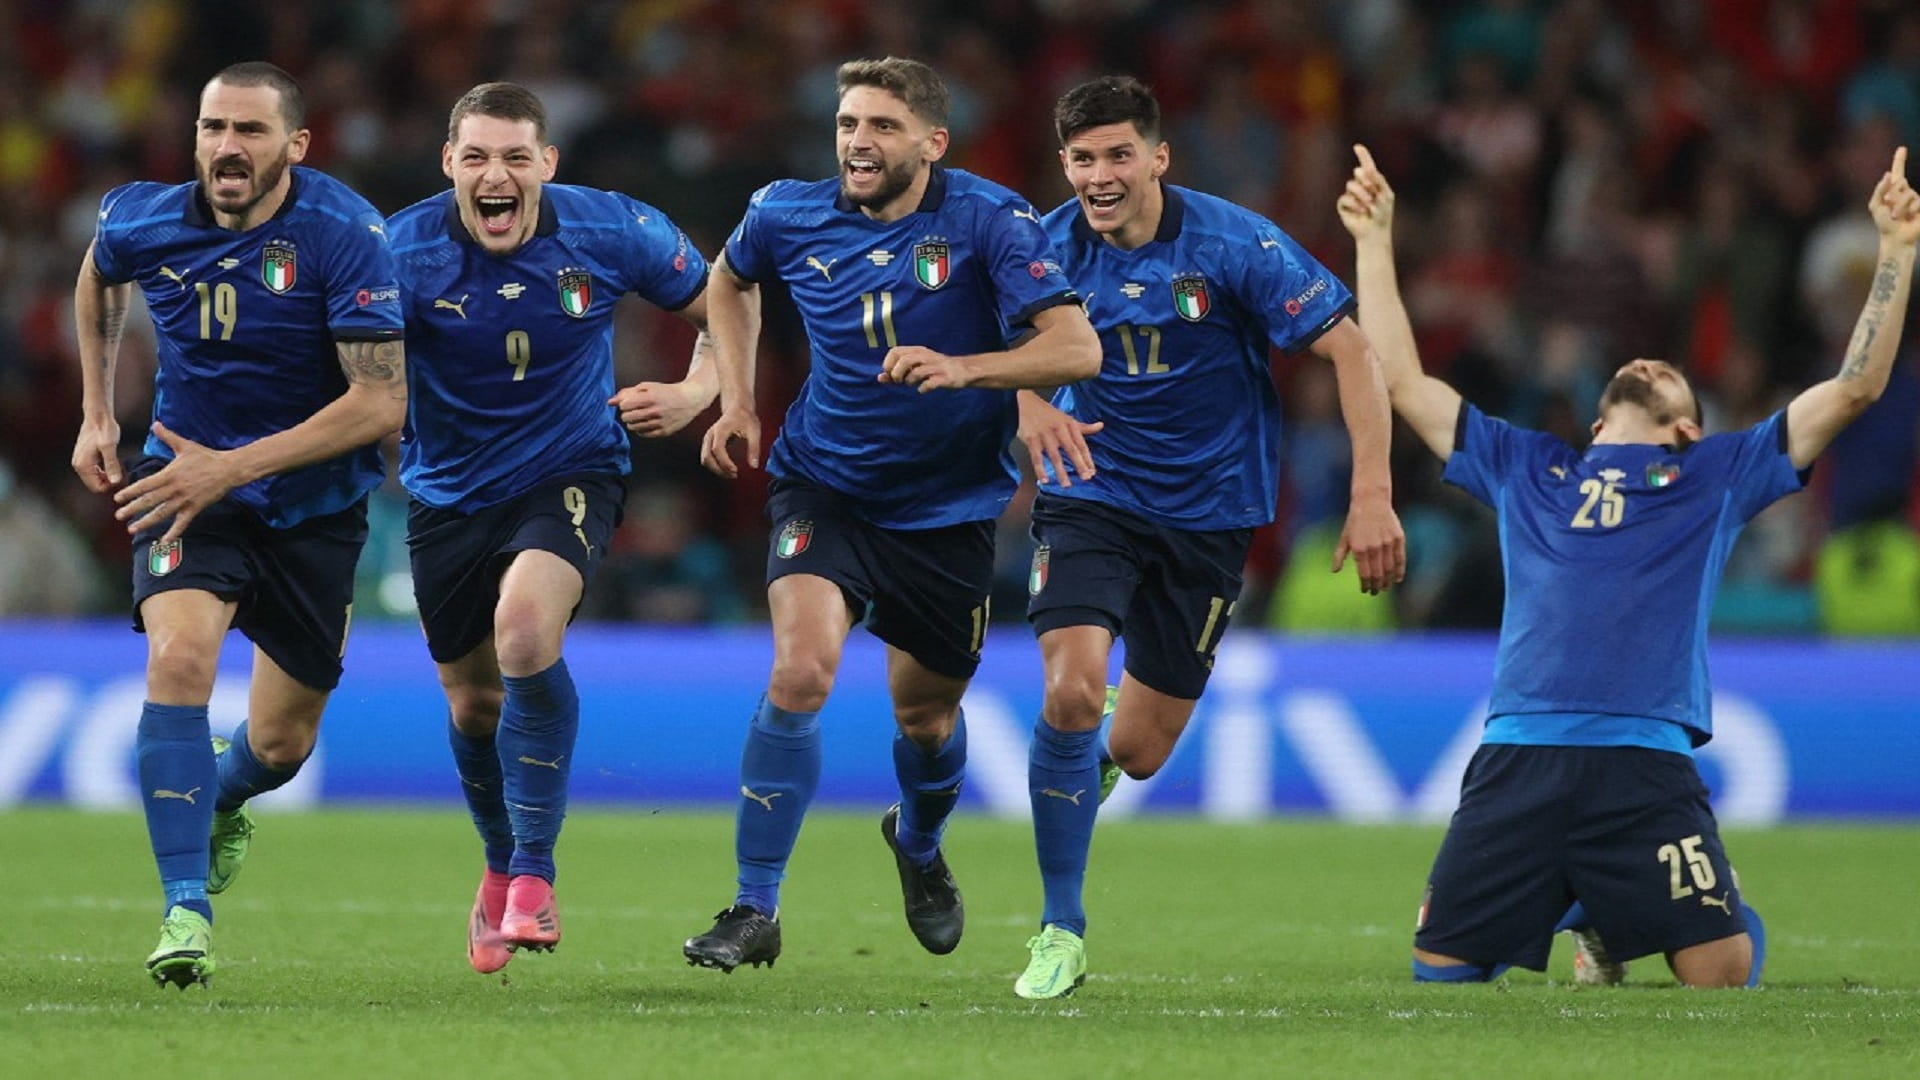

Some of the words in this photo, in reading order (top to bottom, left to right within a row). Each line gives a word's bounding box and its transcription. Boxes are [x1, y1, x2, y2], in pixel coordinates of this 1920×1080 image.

[195, 282, 238, 341] 19
[1297, 279, 1328, 305] RESPECT
[861, 292, 897, 348] 11
[505, 330, 531, 381] 9
[1115, 325, 1170, 375] 12
[563, 486, 587, 527] 9
[1570, 479, 1627, 528] 25
[1657, 834, 1717, 900] 25
